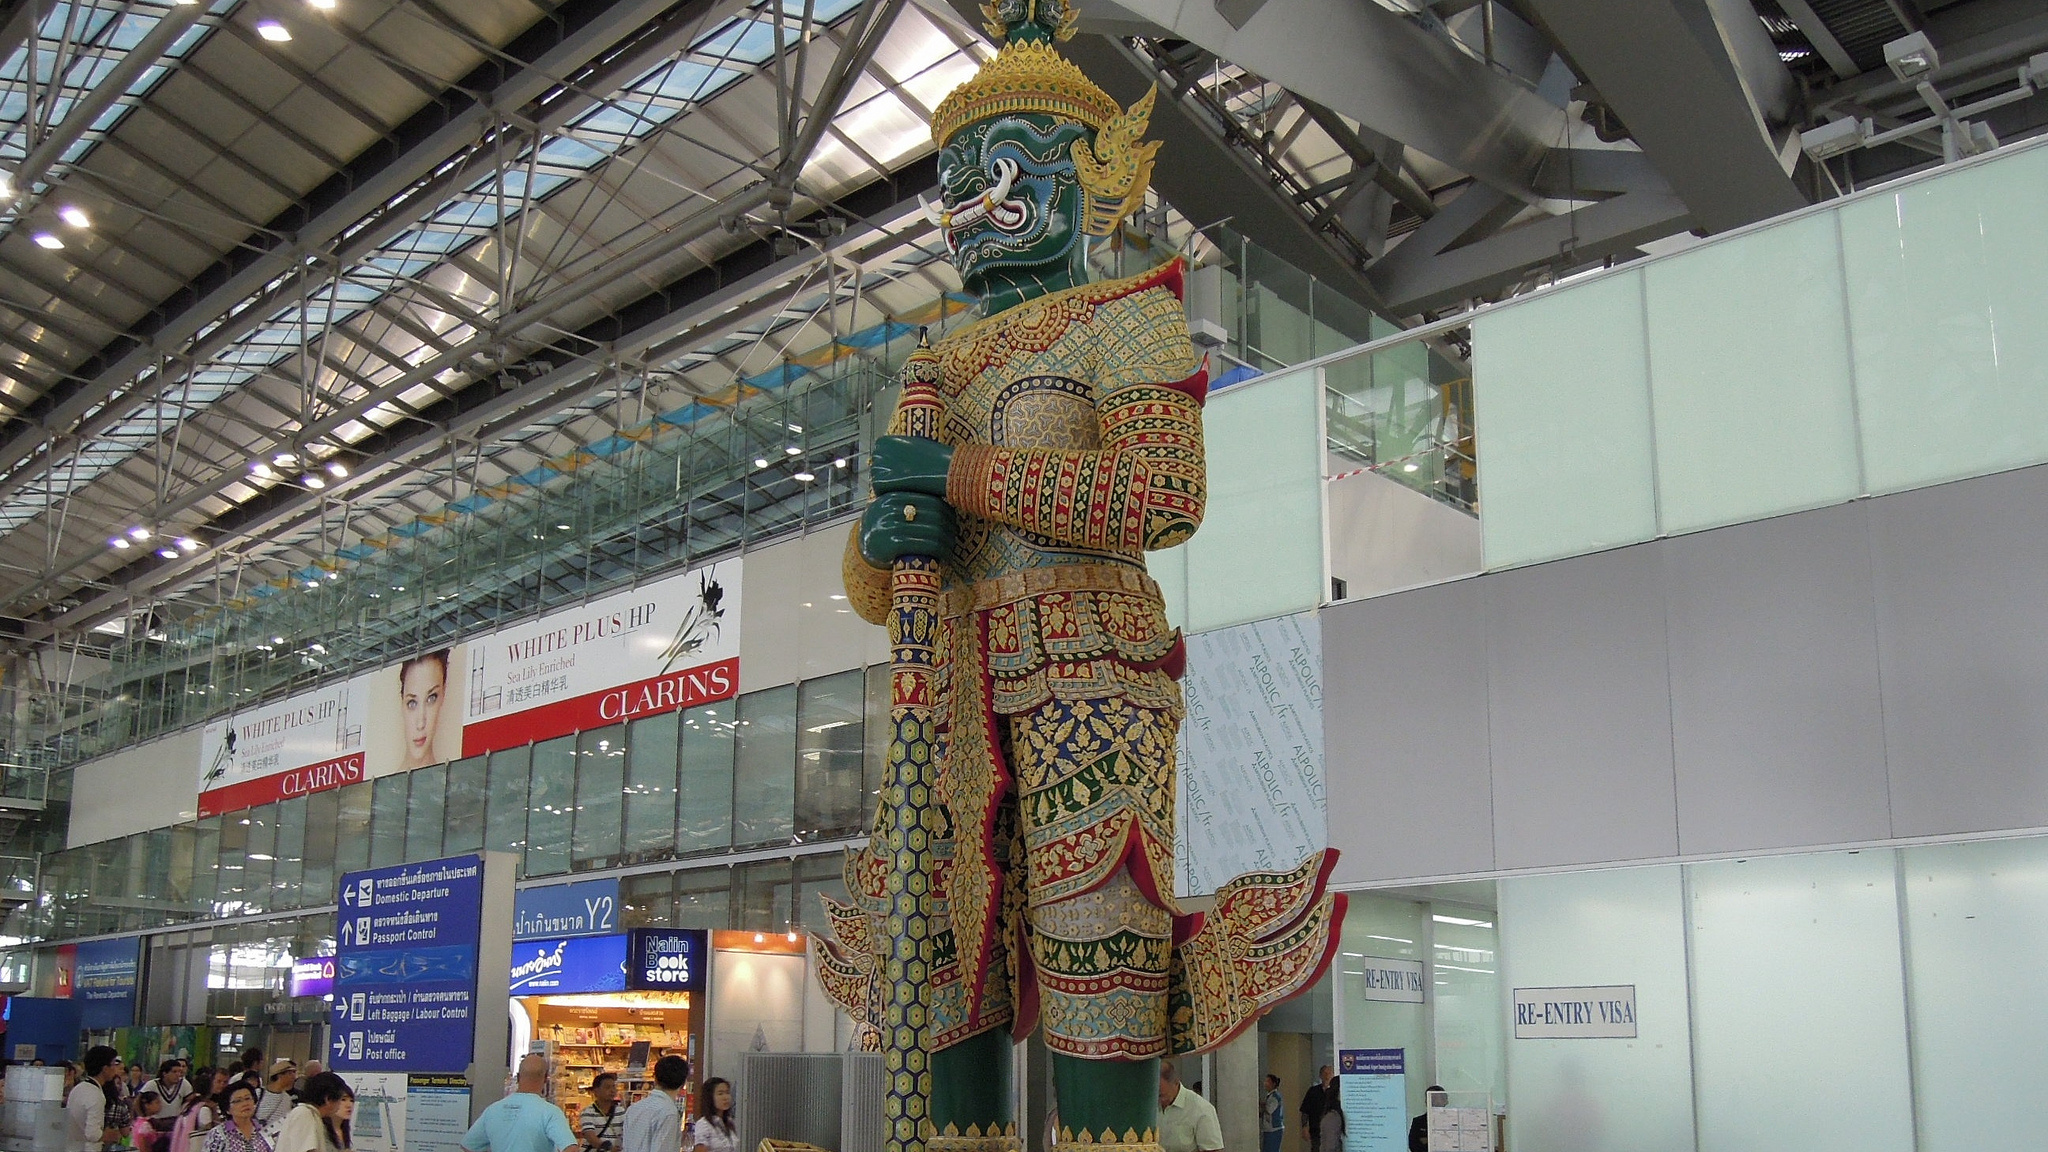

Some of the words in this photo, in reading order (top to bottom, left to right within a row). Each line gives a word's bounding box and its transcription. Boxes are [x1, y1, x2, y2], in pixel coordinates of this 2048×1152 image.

[508, 629, 567, 663] WHITE
[574, 613, 621, 645] PLUS
[628, 603, 656, 629] HP
[507, 671, 521, 686] Sea
[522, 663, 538, 681] Lily
[539, 653, 576, 676] Enriched
[599, 667, 731, 720] CLARINS
[243, 716, 281, 741] WHITE
[284, 706, 314, 732] PLUS
[318, 698, 337, 721] HP
[282, 758, 360, 795] CLARINS
[375, 891, 410, 905] Domestic
[411, 887, 450, 902] Departure
[584, 896, 613, 930] Y2
[372, 931, 406, 945] Passport
[407, 927, 437, 941] Control
[645, 936, 689, 953] Naiin
[645, 952, 688, 969] Book
[645, 968, 689, 983] store
[1365, 969, 1404, 991] RE-ENTRY
[1406, 972, 1423, 991] VISA
[367, 1009, 380, 1020] Left
[381, 1008, 410, 1023] Baggage
[416, 1008, 440, 1019] Labour
[441, 1006, 468, 1019] Control
[1517, 1001, 1593, 1025] RE-ENTRY
[1599, 1001, 1634, 1024] VISA
[366, 1048, 383, 1060] Post
[384, 1048, 406, 1060] office
